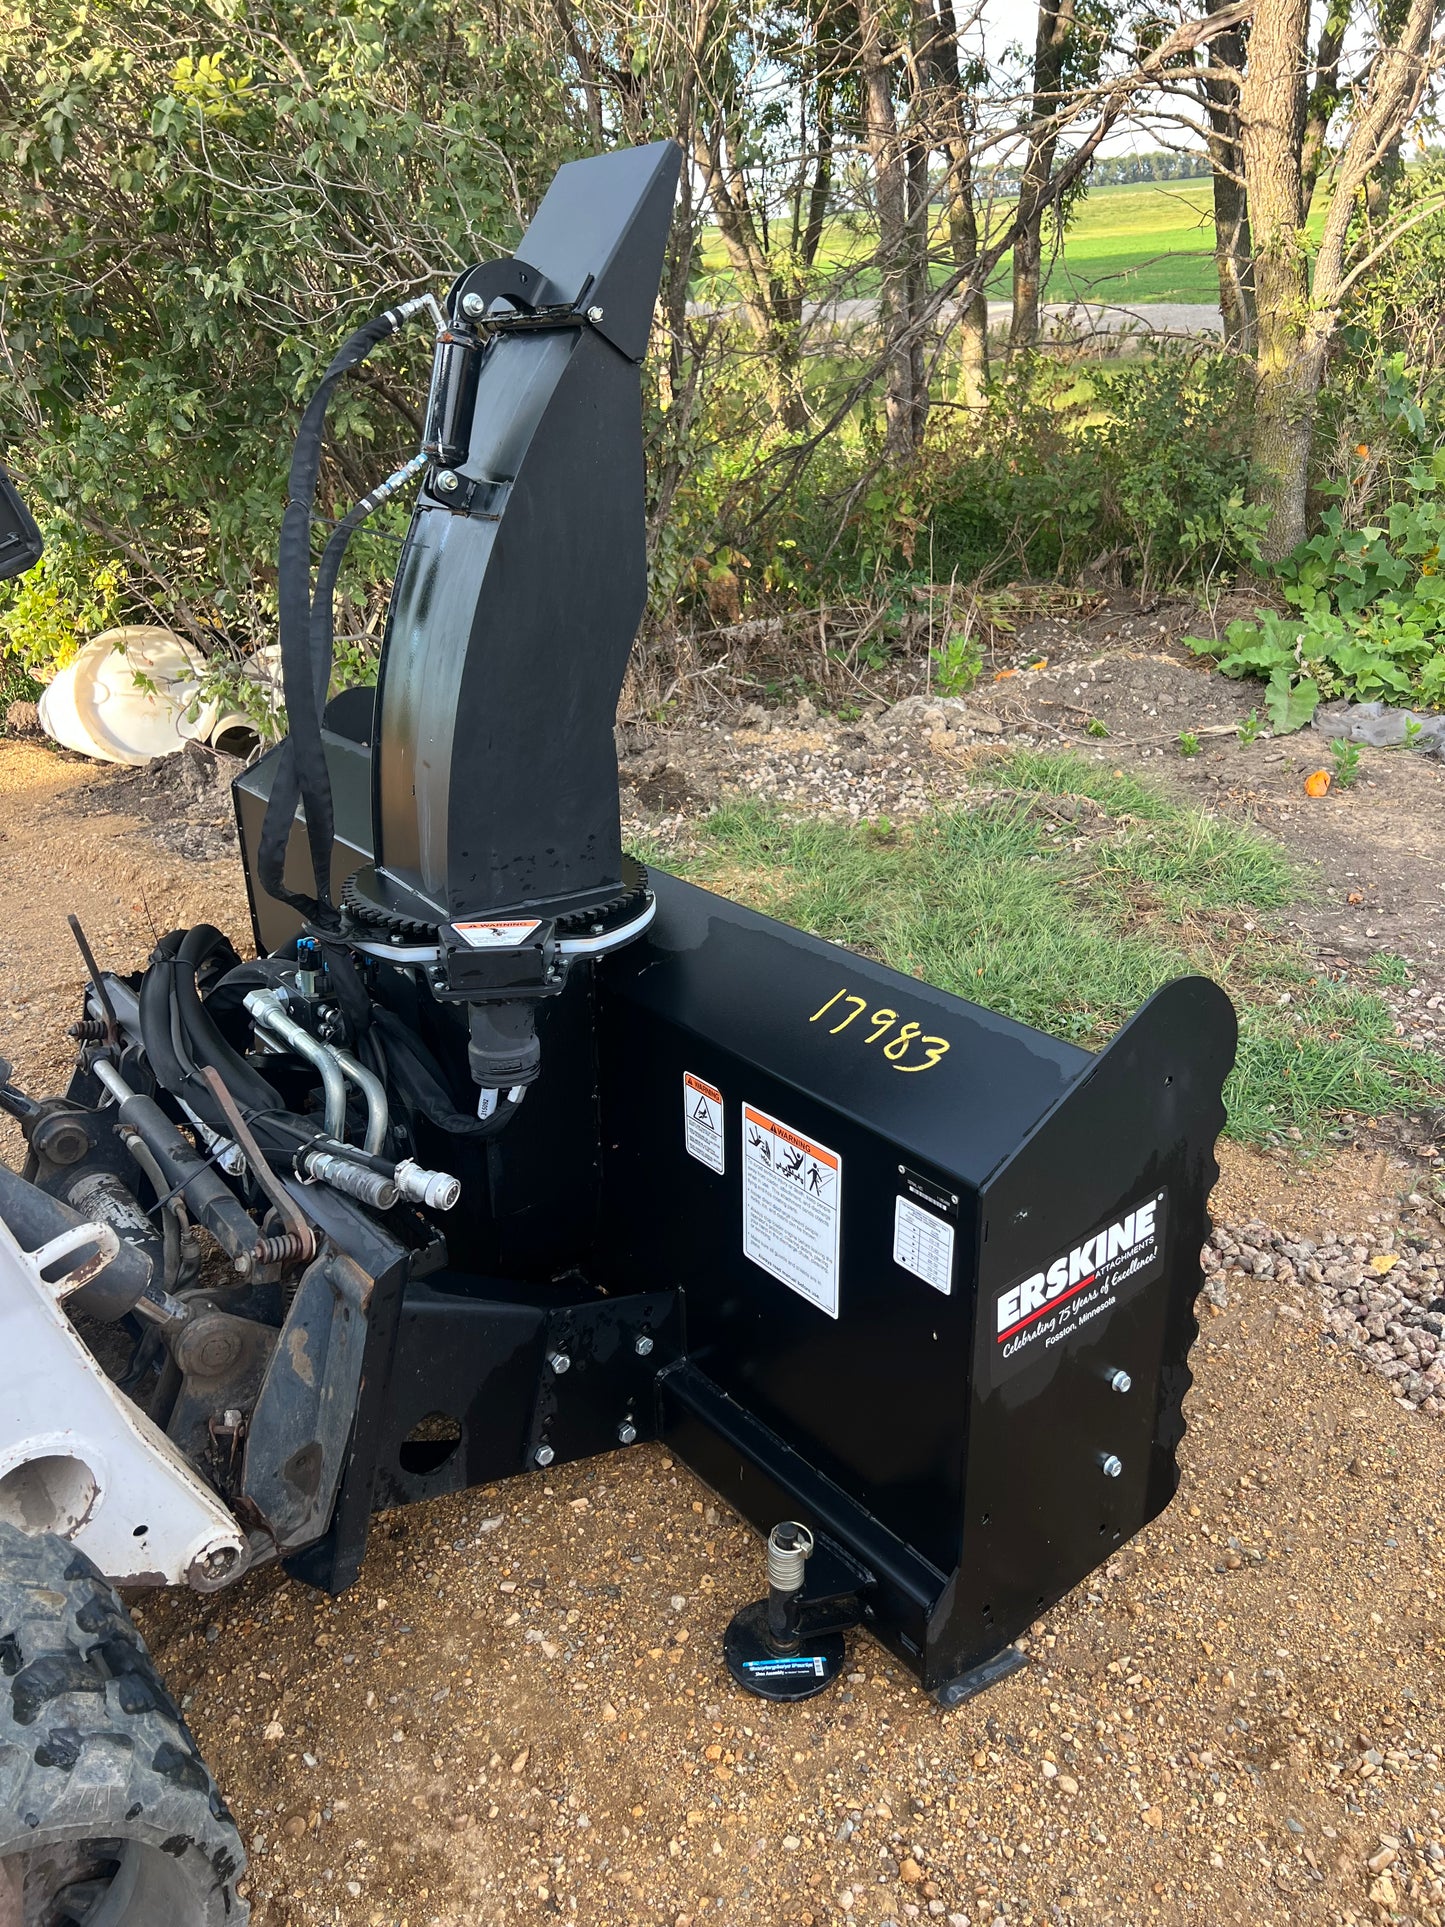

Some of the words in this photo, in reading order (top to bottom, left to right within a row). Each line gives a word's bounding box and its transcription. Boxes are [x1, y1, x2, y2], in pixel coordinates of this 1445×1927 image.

[809, 988, 950, 1072] 17983
[694, 1082, 720, 1101] WARNING
[776, 1124, 812, 1154] WARNING
[998, 1200, 1156, 1333] ERSKINE
[1094, 1236, 1154, 1280] ATTACHMENTS
[1002, 1318, 1056, 1358] Celebrating
[1058, 1306, 1071, 1325] 75
[1072, 1289, 1098, 1315] Years
[1100, 1276, 1110, 1294] of
[1111, 1246, 1158, 1285] Excellence!
[1045, 1322, 1077, 1348] Fosston,
[1079, 1295, 1116, 1325] Minnesota
